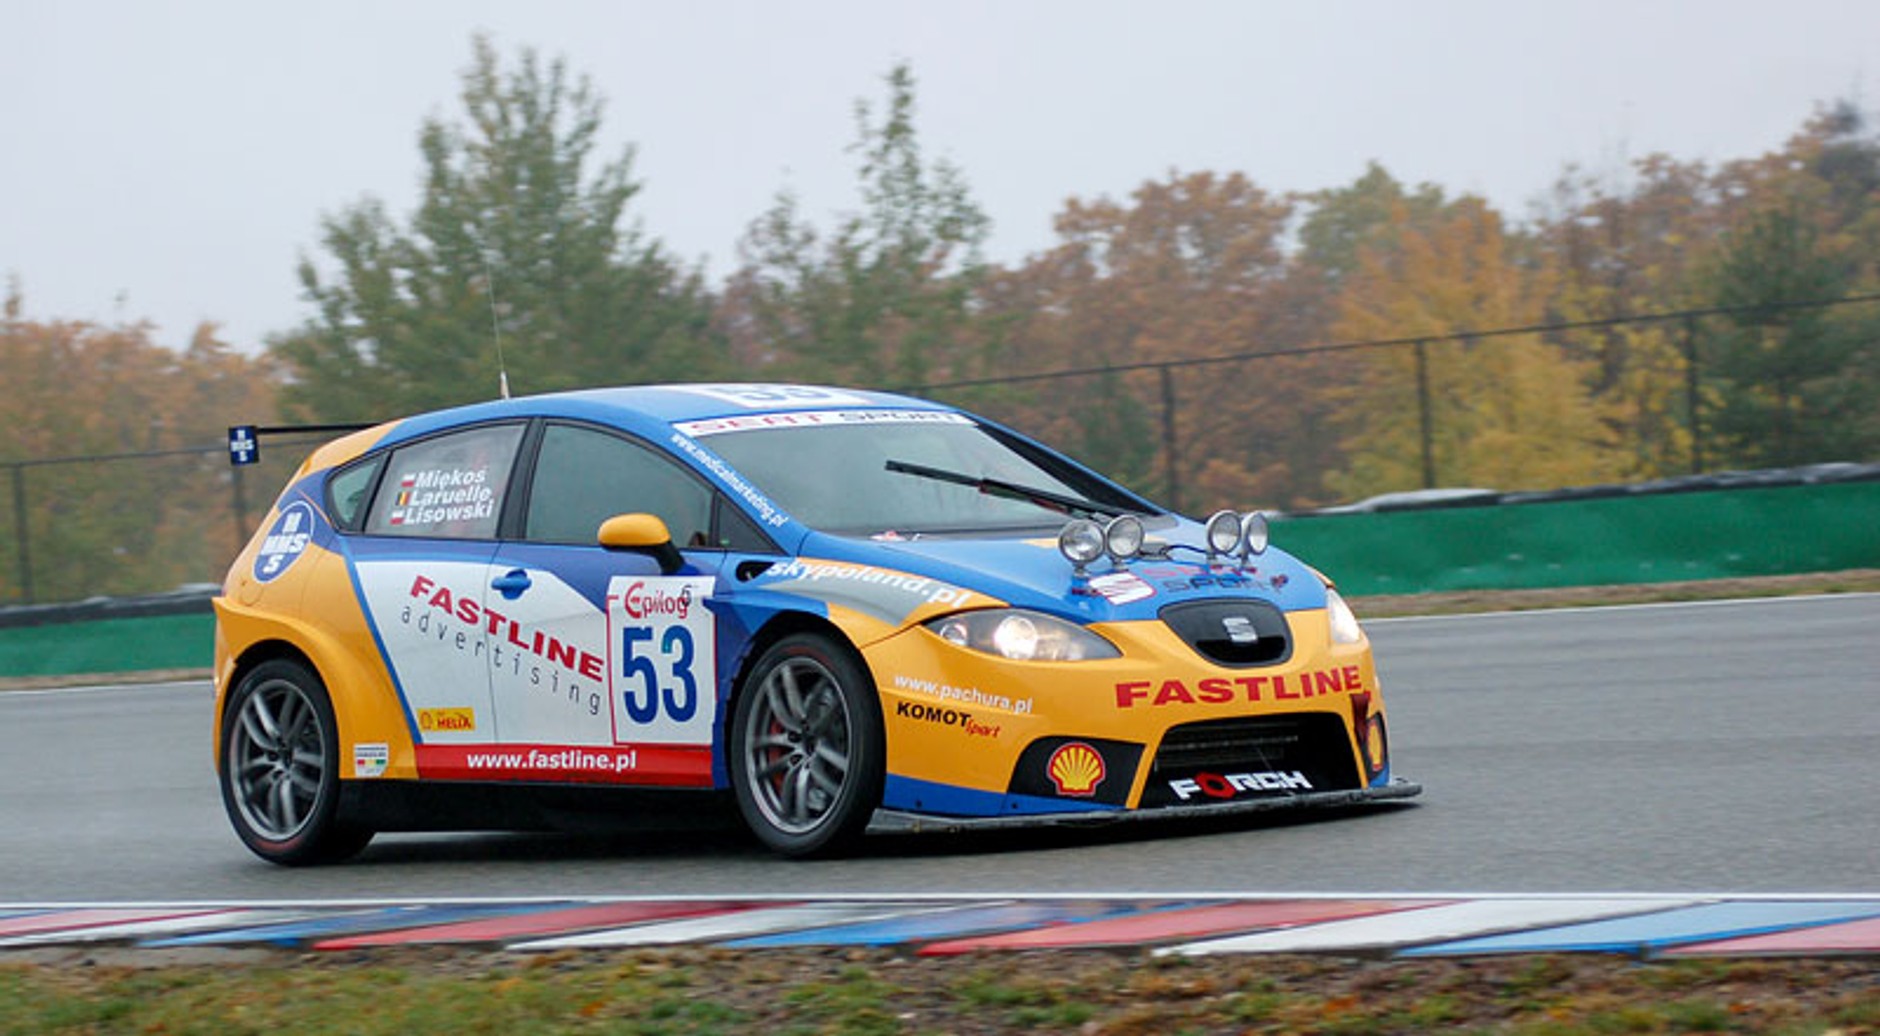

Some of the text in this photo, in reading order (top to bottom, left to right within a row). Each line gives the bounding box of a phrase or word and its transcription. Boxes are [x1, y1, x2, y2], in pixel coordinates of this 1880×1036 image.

[409, 485, 493, 507] Laruelle
[671, 433, 789, 527] www.medicalmarketing.pl
[404, 499, 495, 525] Lisowski
[624, 582, 689, 619] Epilog
[767, 556, 972, 608] skypoland.pl
[410, 575, 604, 682] FASTLINE
[401, 605, 601, 716] advertising
[623, 625, 697, 724] 53
[894, 675, 1034, 715] www.pachura.pl
[1115, 665, 1362, 708] FASTLINE
[897, 701, 971, 728] KOMOT
[466, 749, 637, 773] www.fastline.pl
